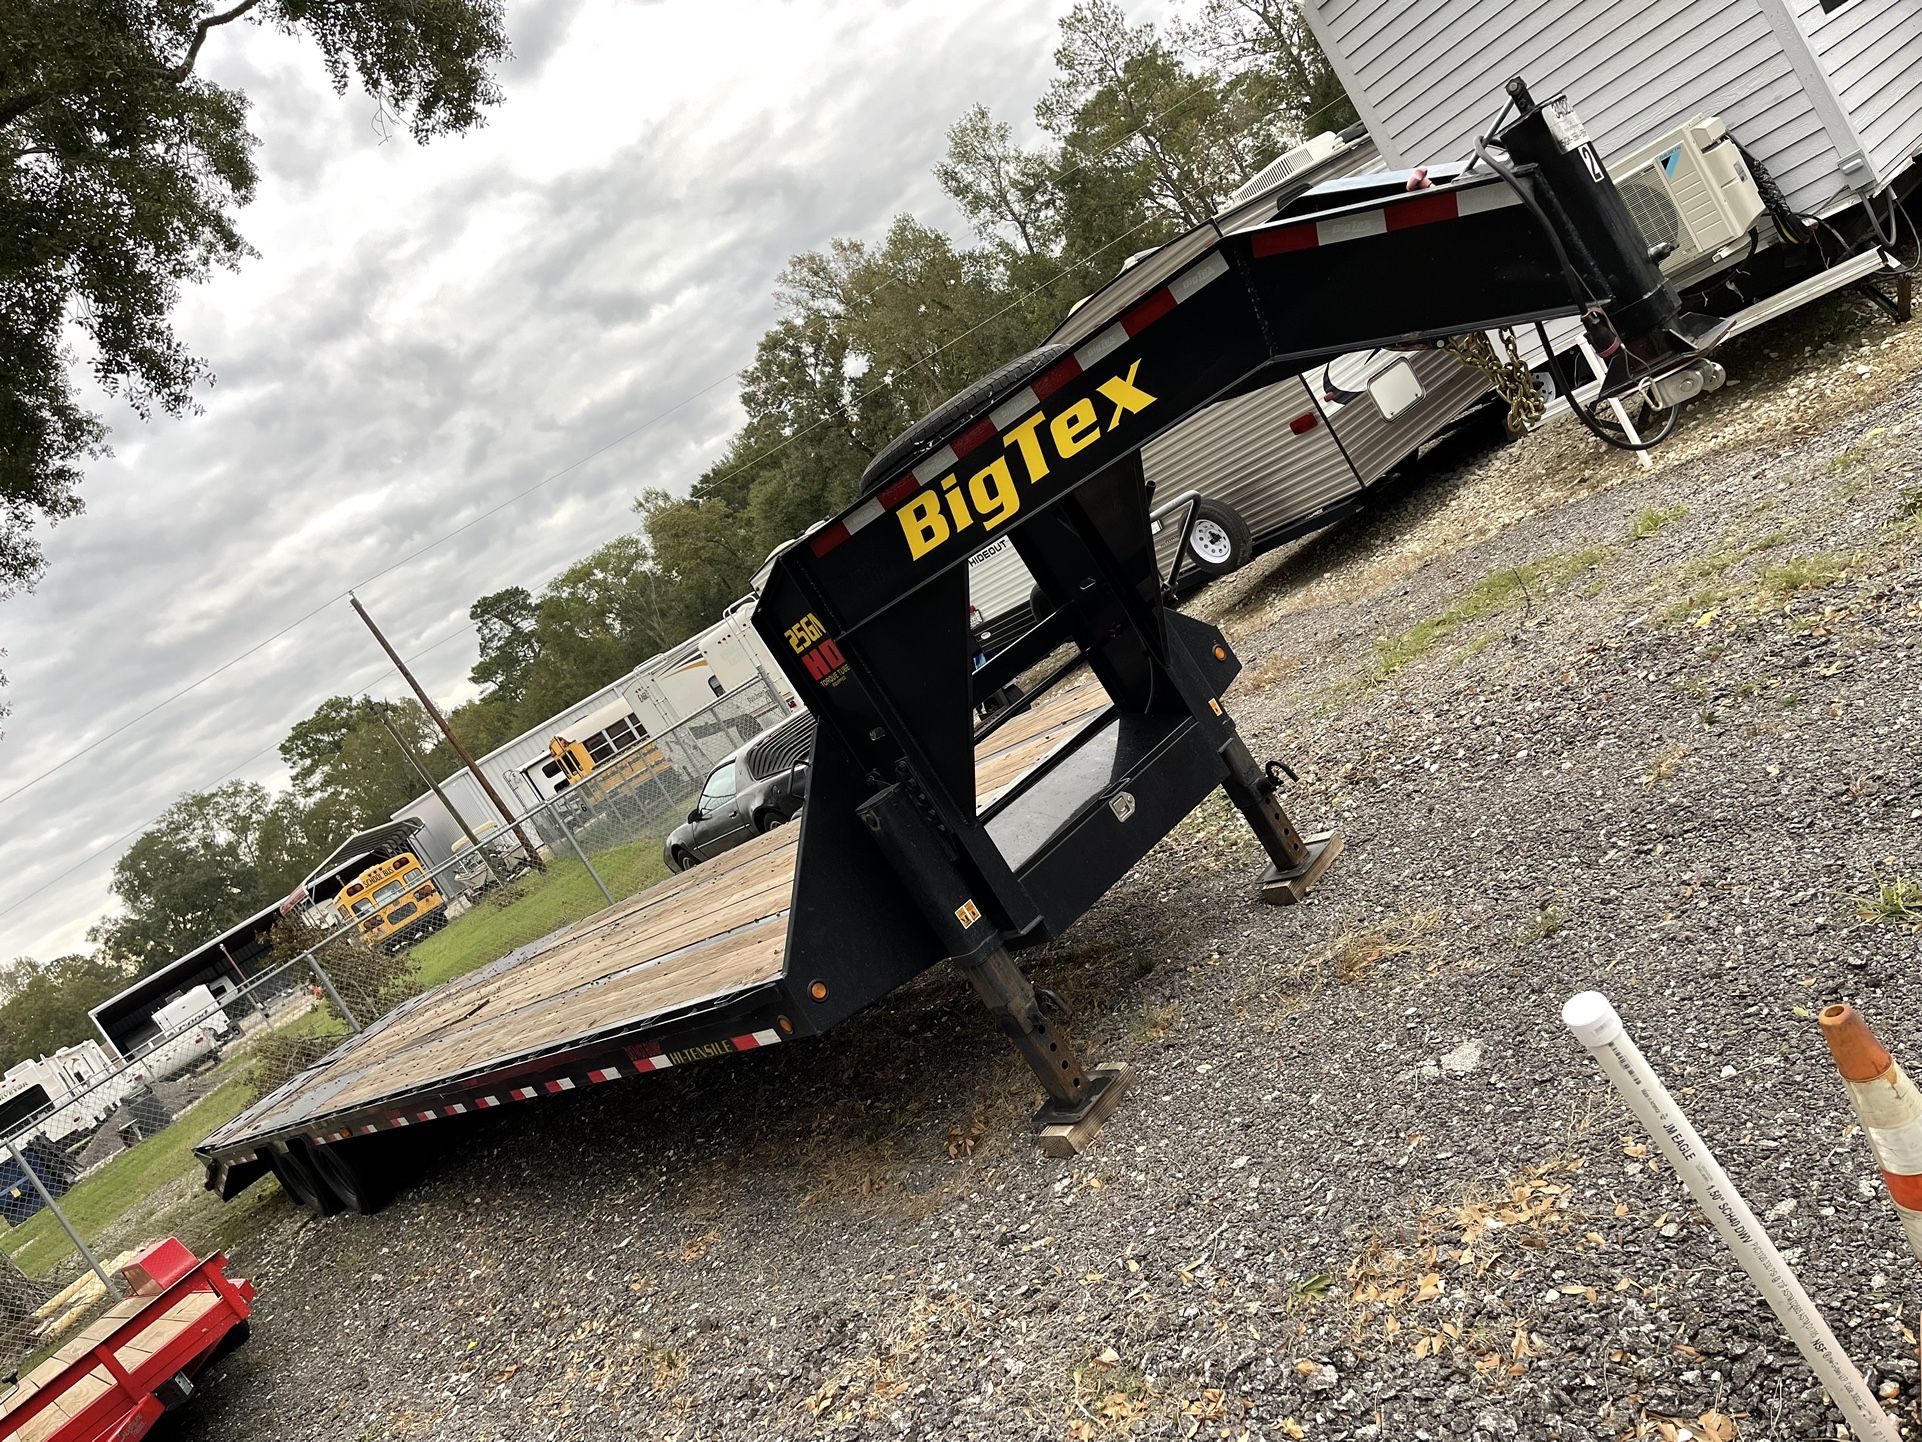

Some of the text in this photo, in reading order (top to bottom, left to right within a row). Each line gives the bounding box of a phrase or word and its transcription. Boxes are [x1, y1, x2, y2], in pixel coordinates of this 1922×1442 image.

[968, 539, 1009, 568] HIDEOUT
[802, 639, 846, 681] HD
[820, 671, 840, 687] TORQUE
[363, 867, 395, 888] SCHOOL BUS
[231, 1025, 241, 1036] 5
[669, 1040, 733, 1065] HI-TENSILE
[1662, 1120, 1678, 1136] JM
[1671, 1132, 1696, 1161] EAGLE
[1705, 1183, 1725, 1205] 1.50"
[1717, 1200, 1741, 1228] SCH40
[1733, 1224, 1752, 1245] DWV
[1781, 1287, 1795, 1302] ASTM
[1797, 1311, 1811, 1326] ASTM
[1810, 1337, 1827, 1355] NSF
